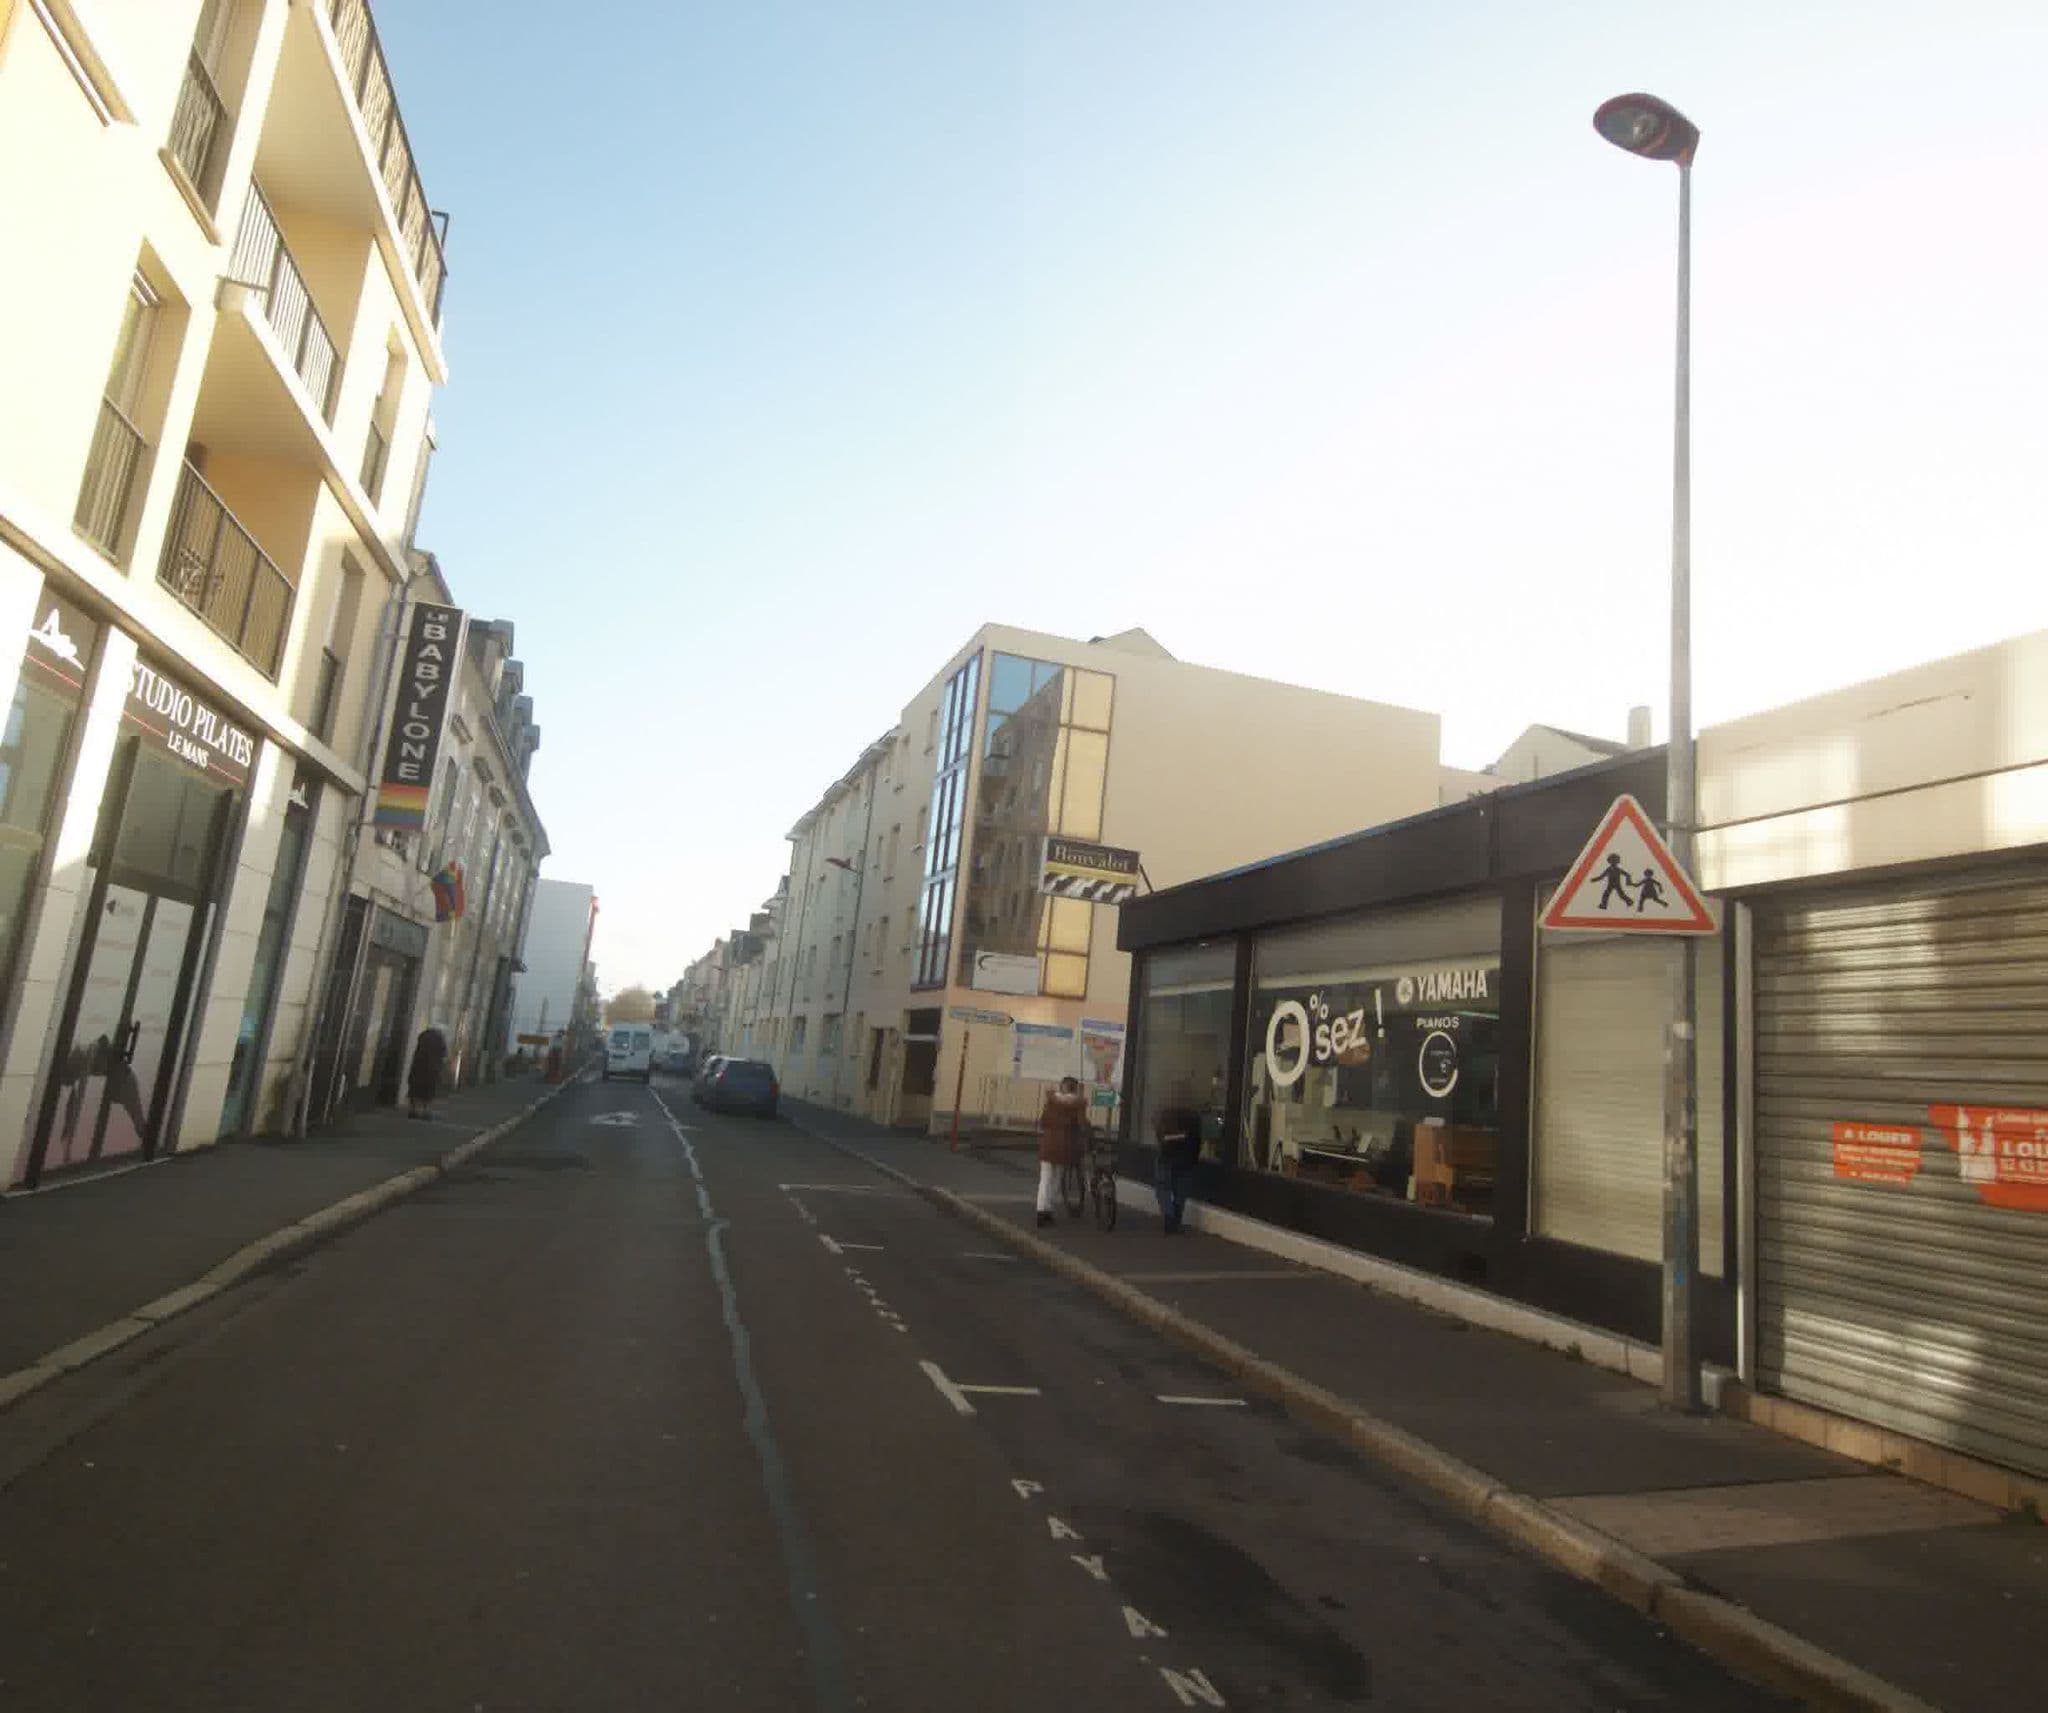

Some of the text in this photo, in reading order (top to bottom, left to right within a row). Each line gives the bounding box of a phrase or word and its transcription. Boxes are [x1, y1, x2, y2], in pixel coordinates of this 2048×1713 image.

[398, 623, 447, 780] BABYLONE
[191, 703, 254, 768] PILATES
[1417, 969, 1488, 1001] YAMAHA
[1416, 1016, 1460, 1029] PIANOS
